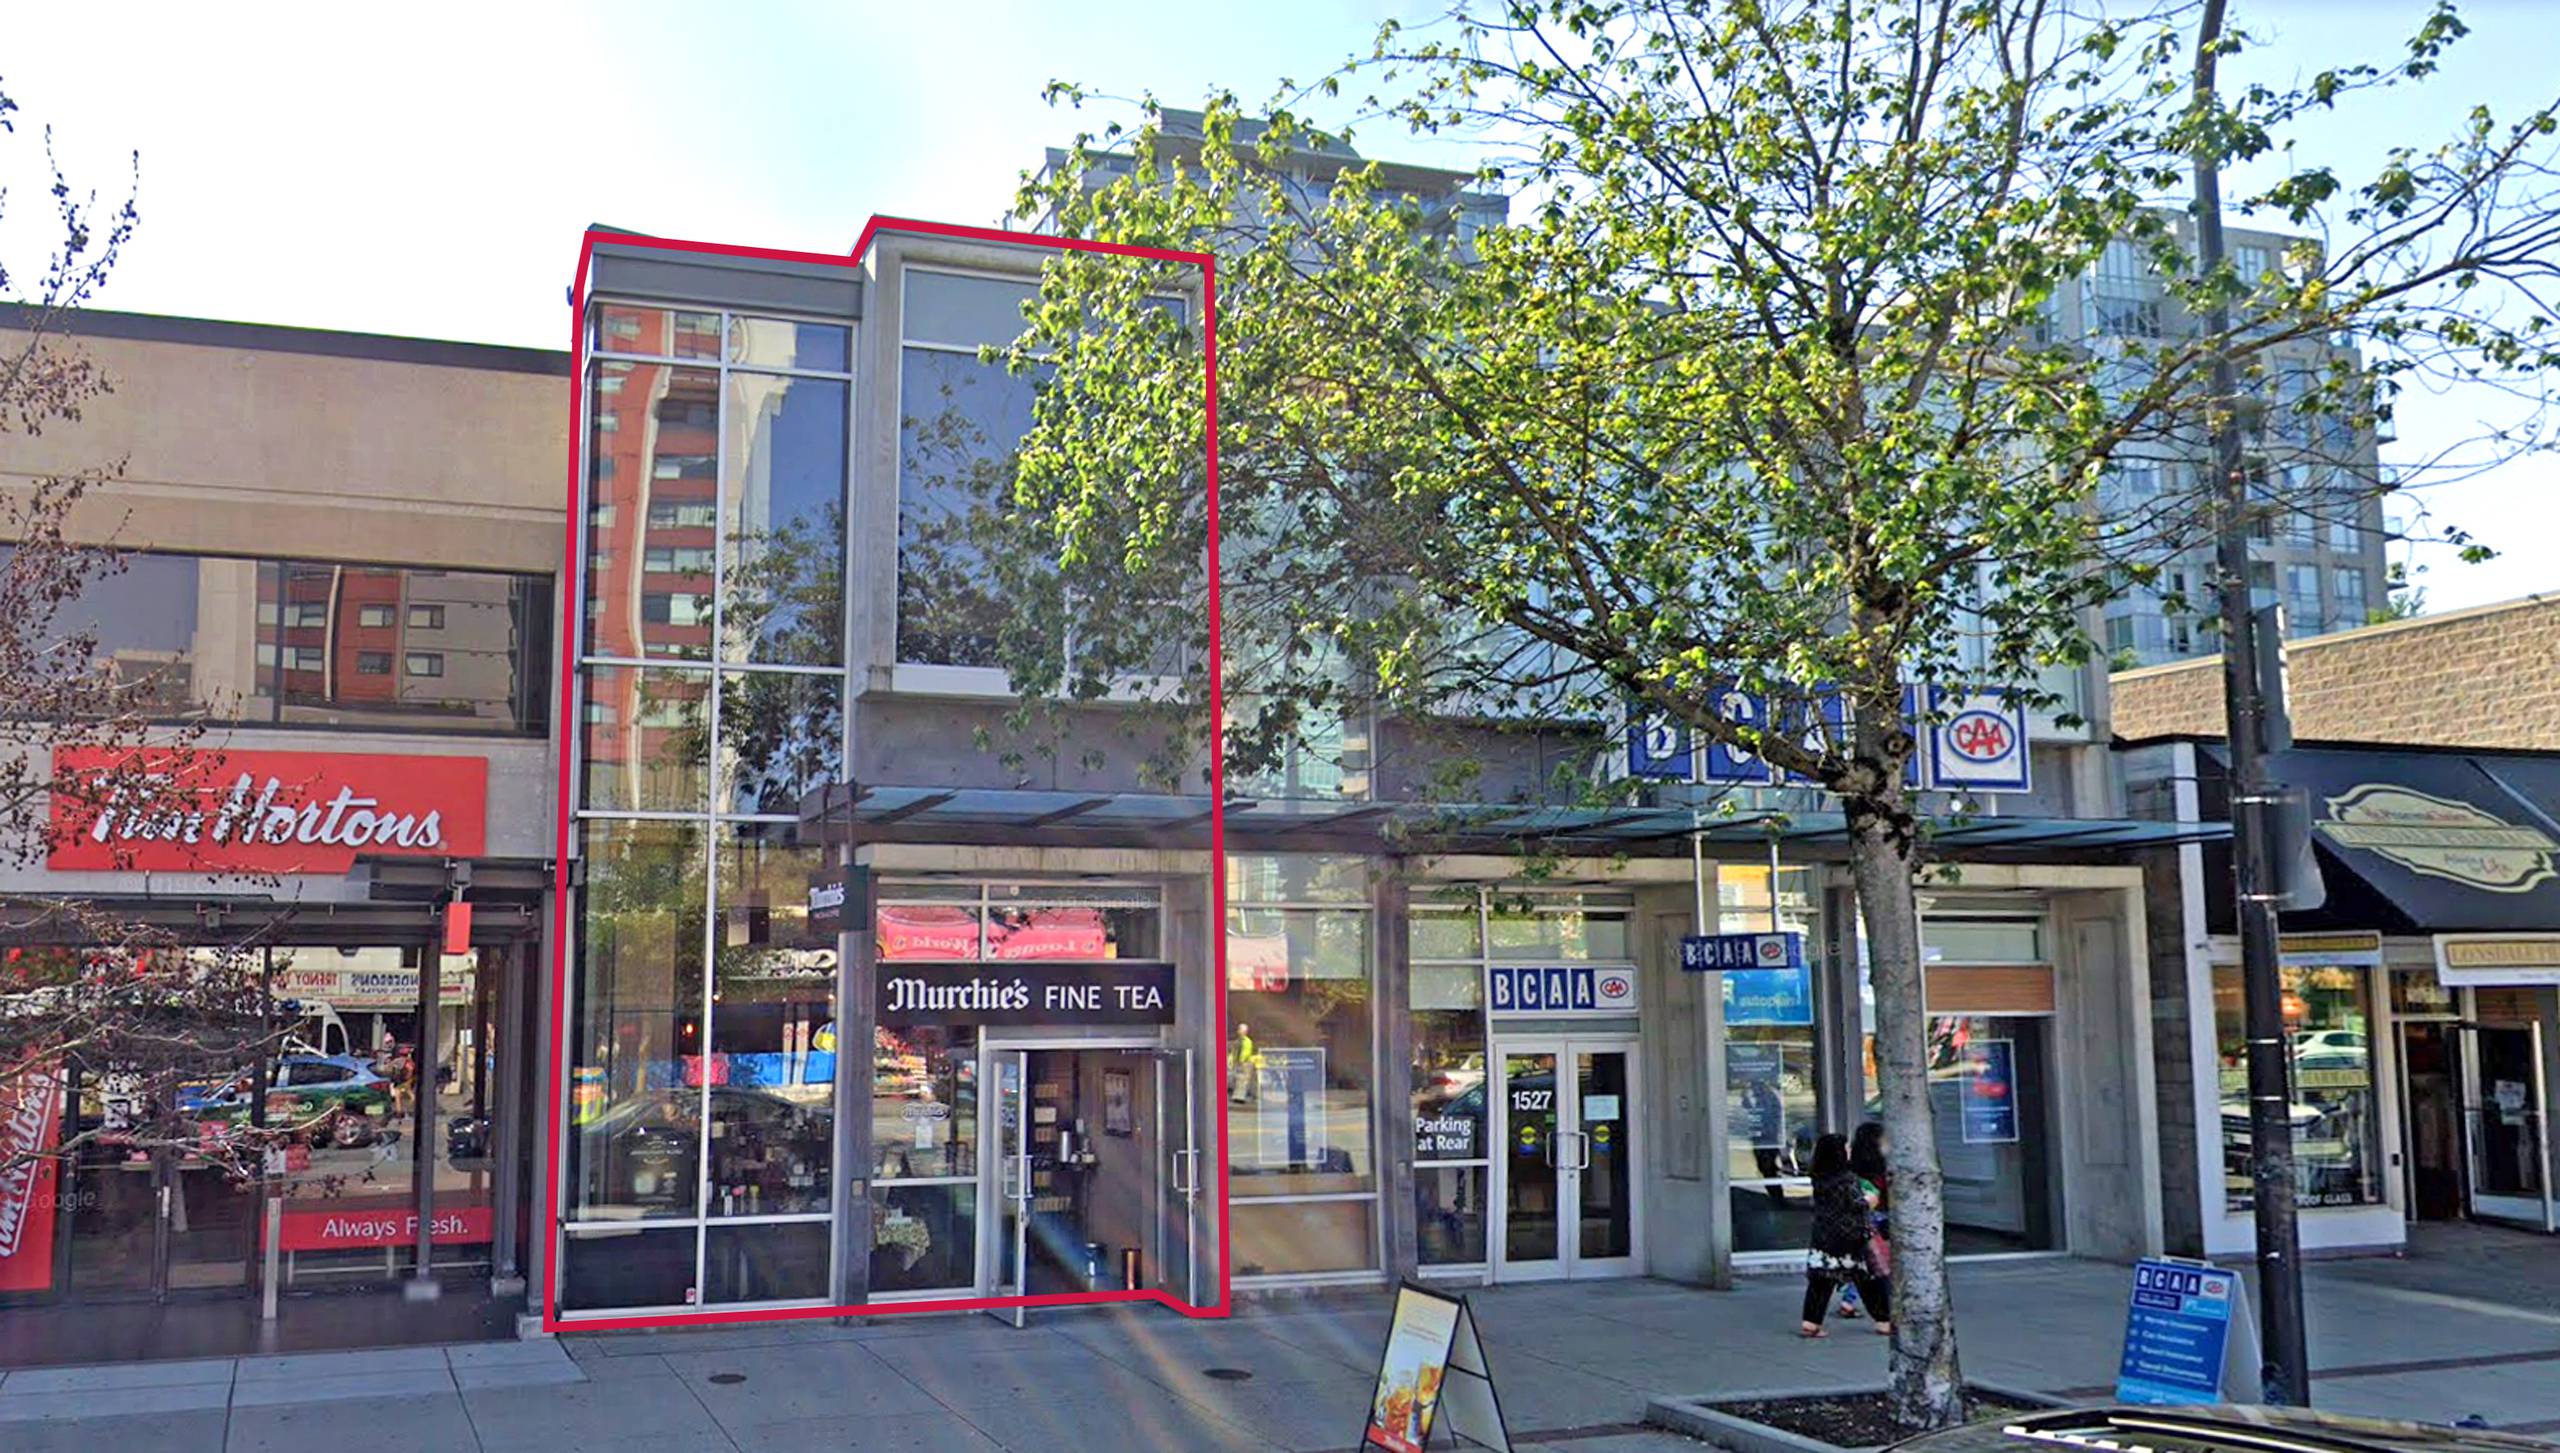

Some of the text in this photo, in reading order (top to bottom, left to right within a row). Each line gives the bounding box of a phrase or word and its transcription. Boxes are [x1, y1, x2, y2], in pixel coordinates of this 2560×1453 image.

[211, 772, 441, 848] Hortons
[1686, 941, 1753, 965] BCAA
[886, 977, 1164, 1012] Murchie's FINE TEA
[1495, 972, 1591, 1006] BCAA
[1511, 1091, 1553, 1111] 1527
[1415, 1117, 1472, 1136] Parking
[1417, 1136, 1471, 1151] at Rear
[322, 1215, 468, 1241] Always Fesh.
[2139, 1269, 2199, 1293] BCAA
